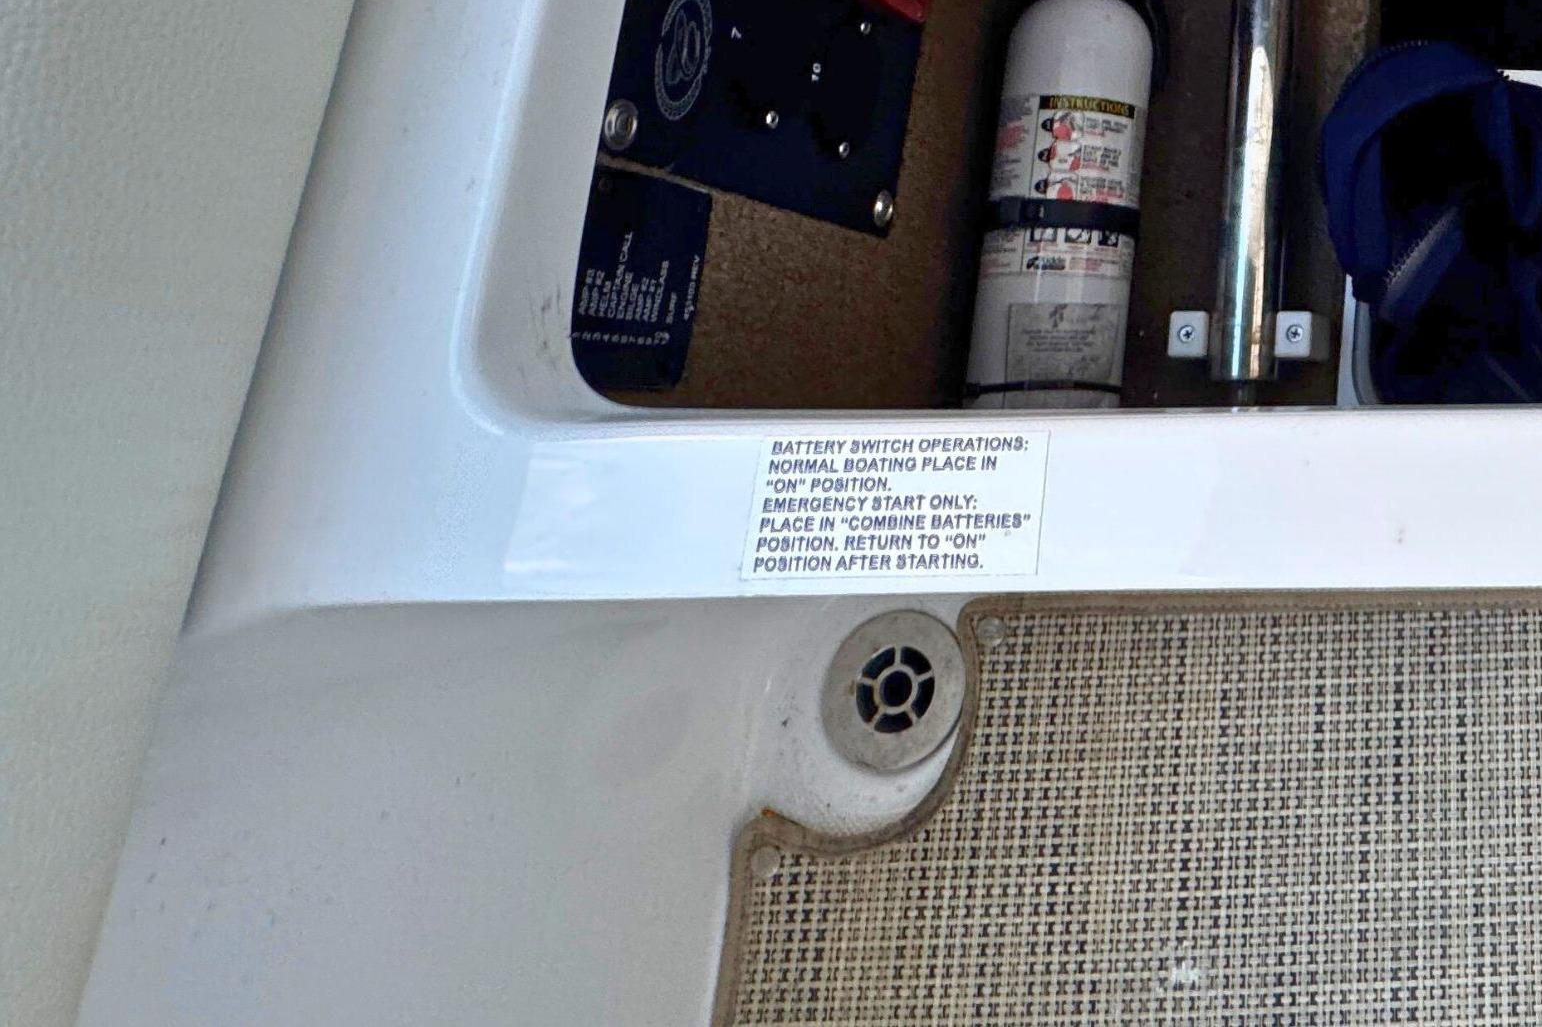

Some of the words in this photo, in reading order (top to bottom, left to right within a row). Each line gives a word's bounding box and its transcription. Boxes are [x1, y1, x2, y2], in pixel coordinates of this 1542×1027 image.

[731, 26, 742, 38] 7
[811, 62, 821, 82] 10
[771, 439, 846, 455] BATTERY
[850, 438, 913, 454] SWITCH
[919, 436, 1029, 452] OPERATIONS:
[768, 459, 839, 474] NORMAL
[844, 457, 917, 473] BOATING
[922, 456, 977, 471] PLACE
[981, 455, 998, 470] IN
[810, 477, 892, 493] POSITION.
[762, 497, 868, 513] EMERGENCY
[872, 495, 926, 511] START
[930, 494, 977, 509] ONLY:
[759, 516, 814, 533] PLACE
[818, 516, 835, 532] IN
[756, 535, 839, 553] POSITION.
[843, 534, 912, 551] RETURN
[918, 534, 940, 550] TO
[753, 555, 832, 573] POSITION
[835, 554, 891, 571] AFTER
[896, 553, 984, 570] STARTING.
